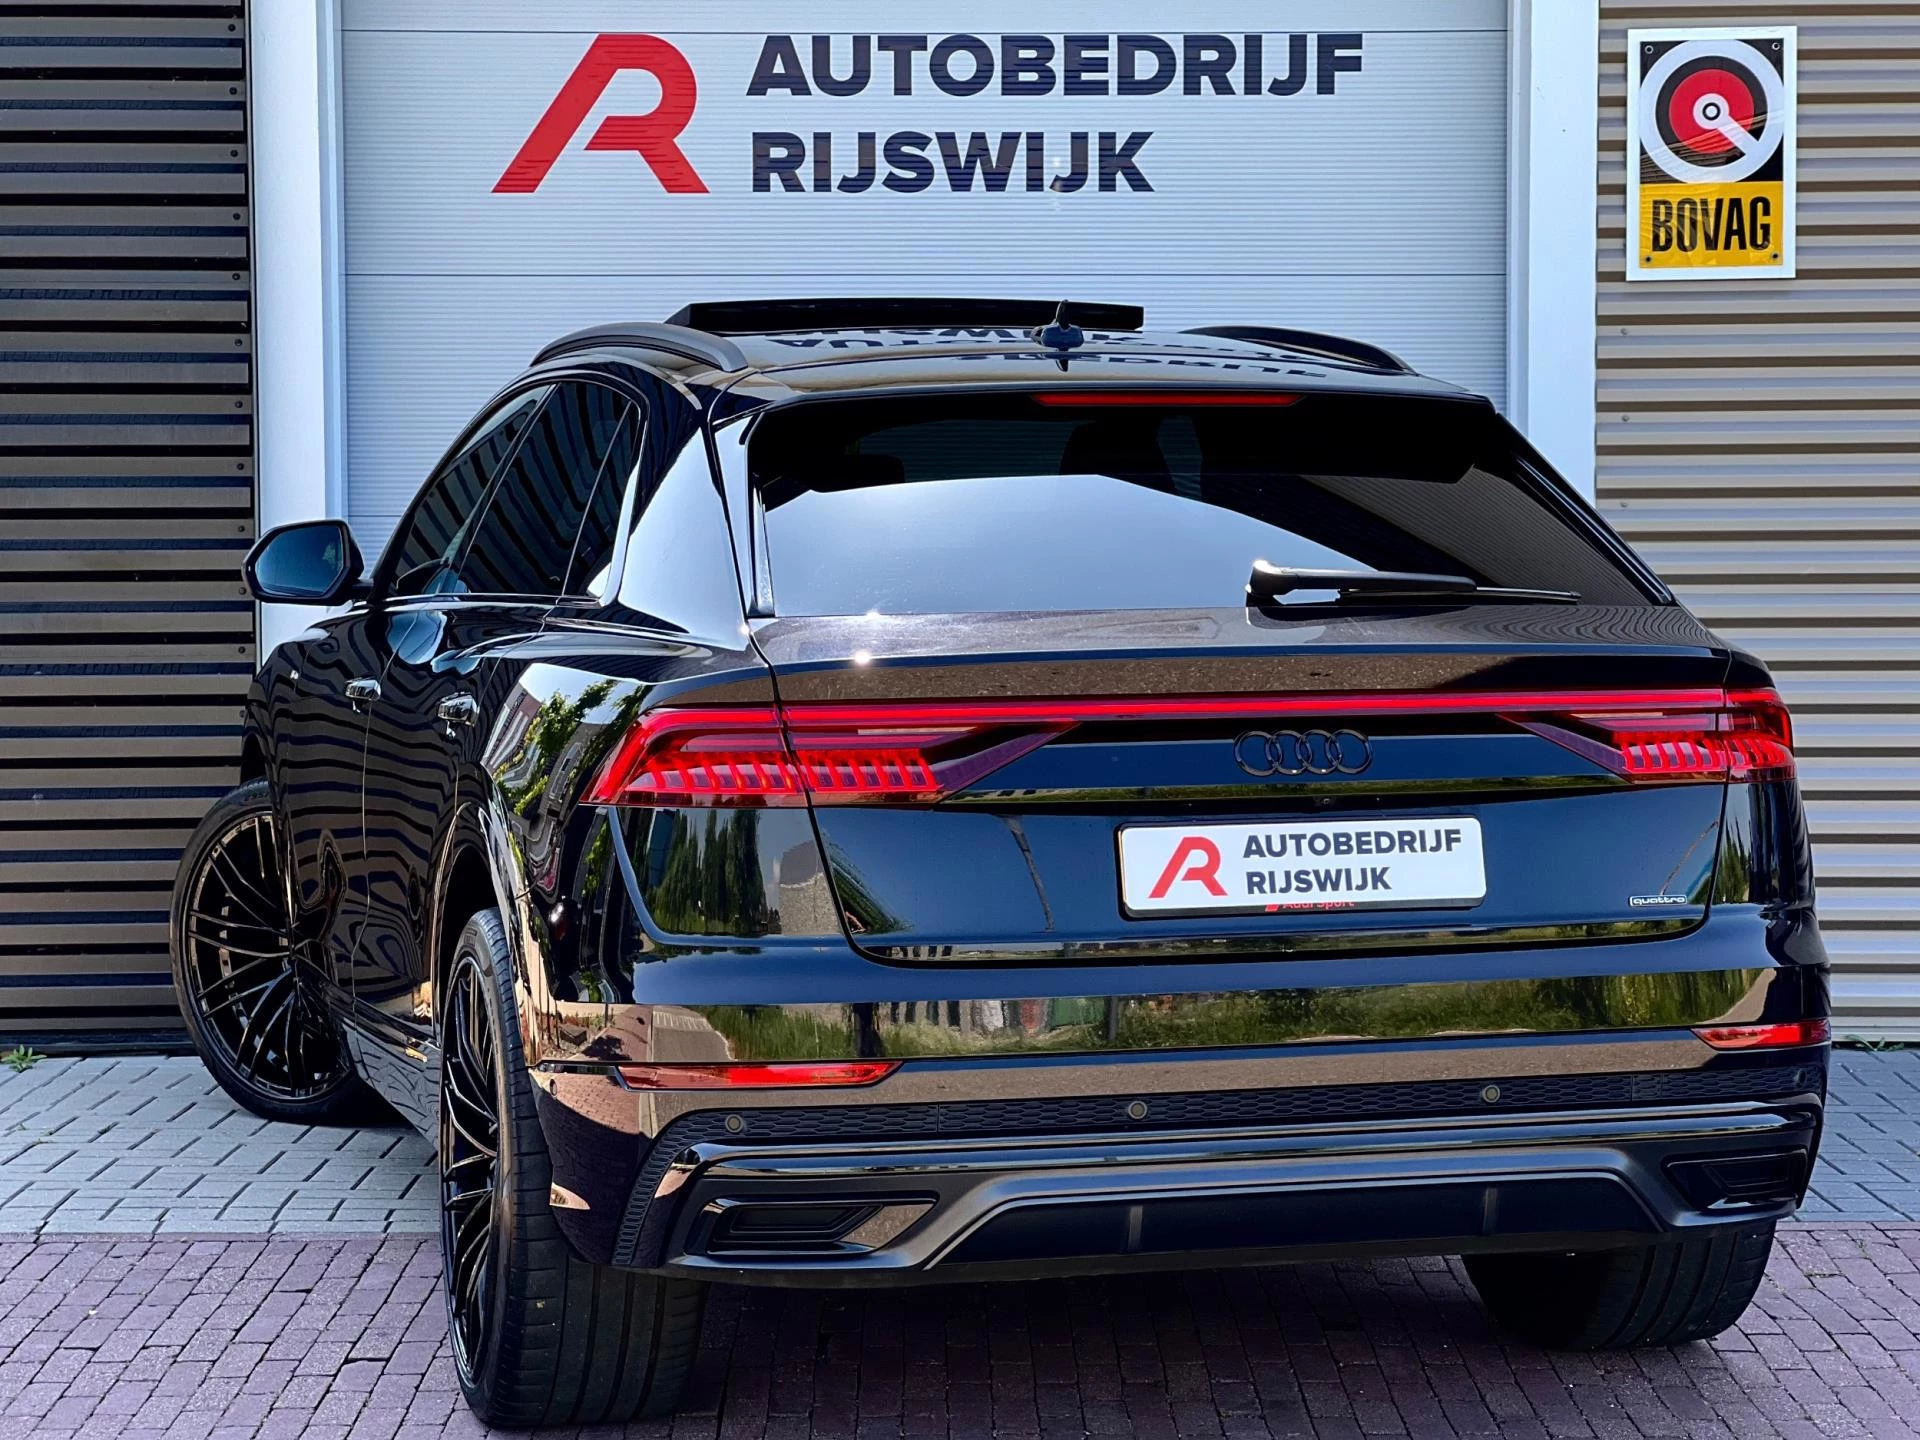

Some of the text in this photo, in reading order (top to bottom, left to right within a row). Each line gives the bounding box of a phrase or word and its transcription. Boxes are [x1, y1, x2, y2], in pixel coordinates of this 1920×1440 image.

[747, 33, 1363, 96] AUTOBEDRIJF
[752, 131, 1156, 193] RIJSWIJK
[1651, 196, 1771, 252] BOVAG
[1242, 829, 1462, 858] AUTOBEDRIJF
[1246, 866, 1392, 895] RIJSWIJK
[1633, 897, 1685, 905] quattro
